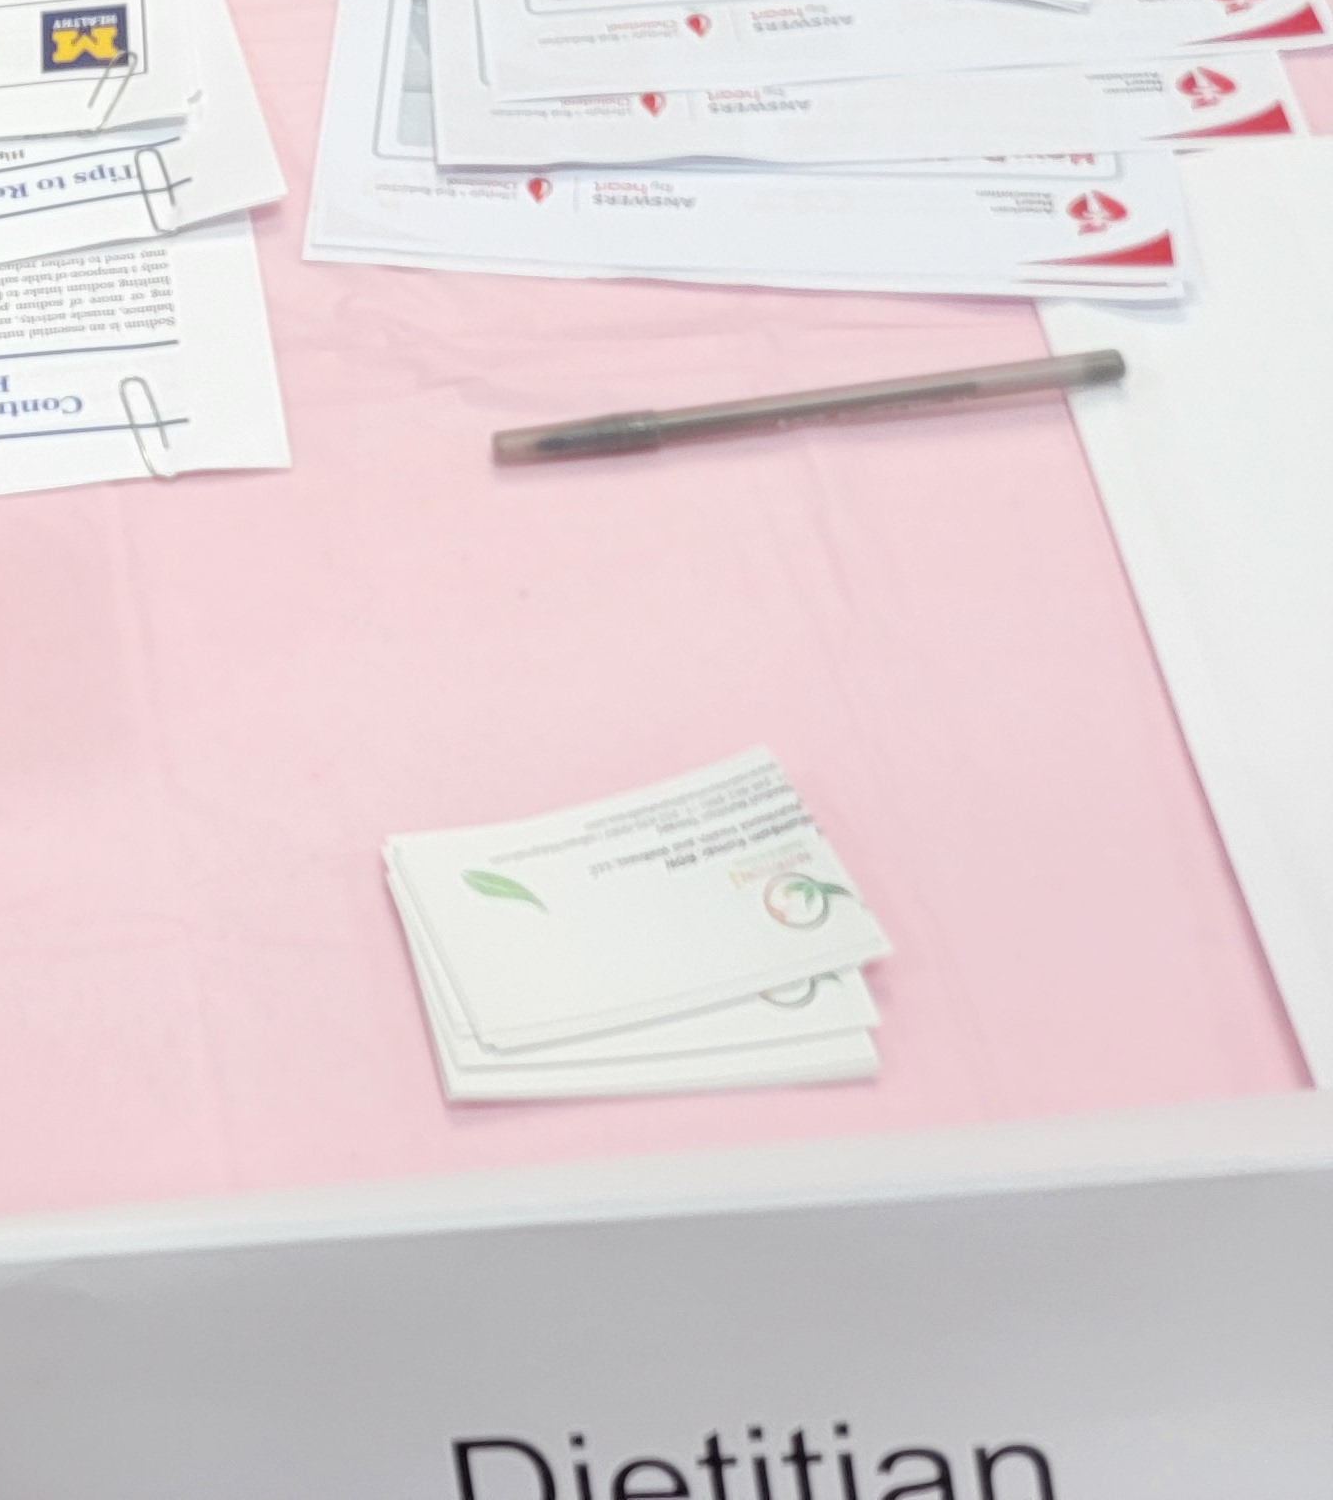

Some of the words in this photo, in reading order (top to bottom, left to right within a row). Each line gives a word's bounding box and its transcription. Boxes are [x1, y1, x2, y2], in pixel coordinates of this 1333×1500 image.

[51, 13, 117, 29] HEALTHY
[50, 25, 117, 62] M
[36, 176, 67, 190] to
[72, 164, 133, 184] Tips
